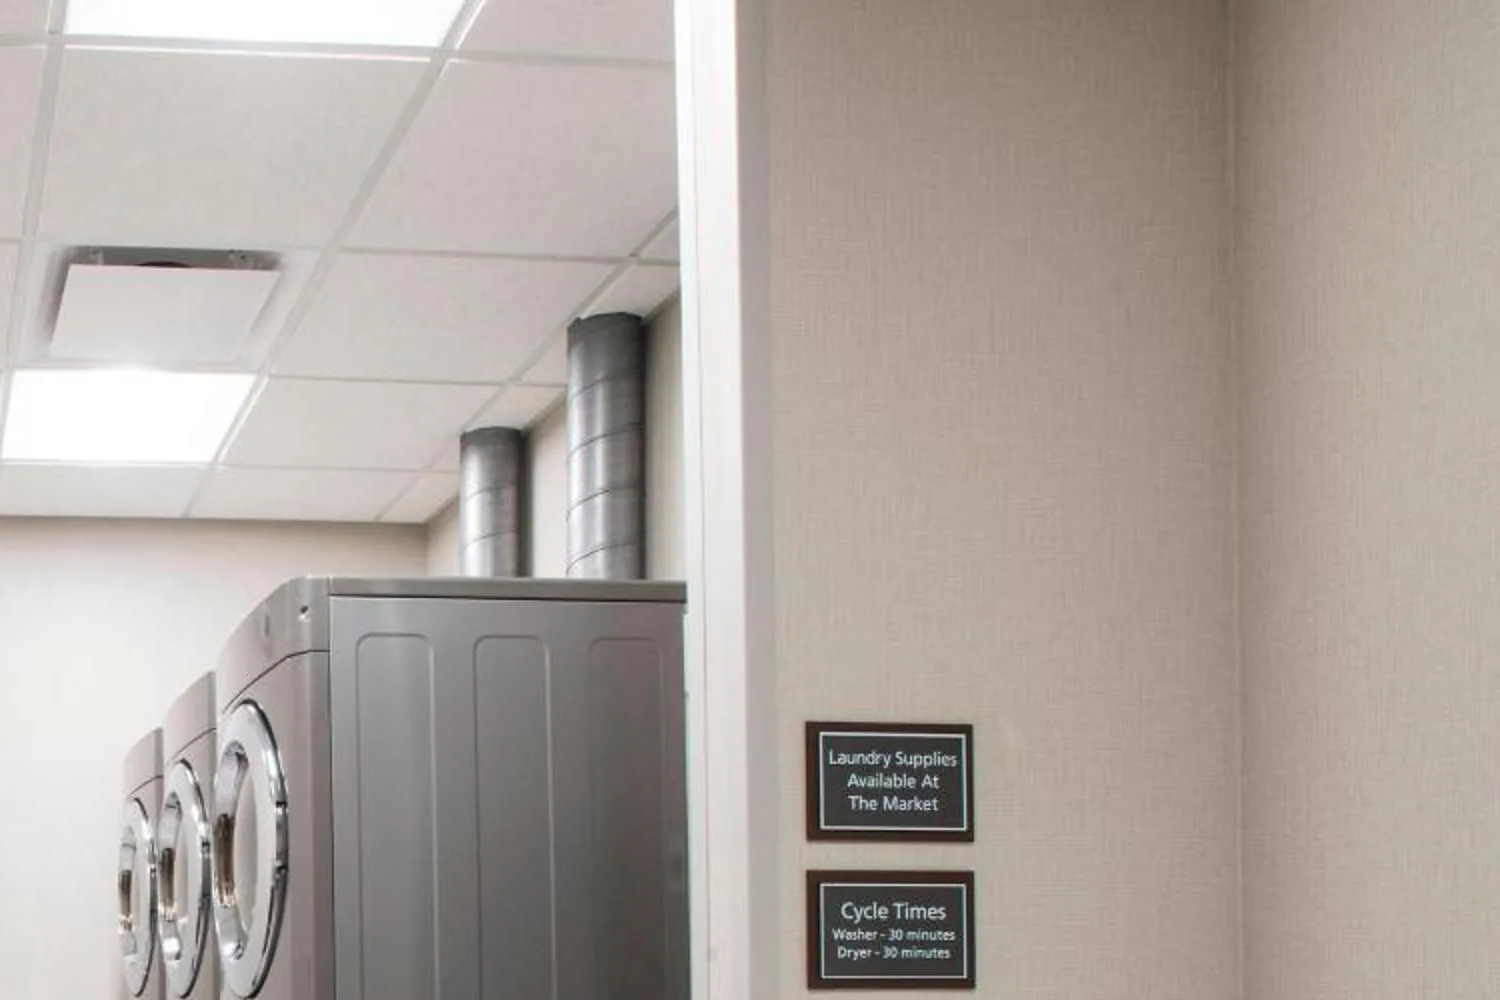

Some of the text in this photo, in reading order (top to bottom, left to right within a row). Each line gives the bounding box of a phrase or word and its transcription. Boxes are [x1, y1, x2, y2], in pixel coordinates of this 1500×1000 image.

[828, 749, 957, 768] Laundry Supplies
[847, 772, 940, 789] Available At
[847, 795, 940, 812] The Market
[841, 901, 947, 924] Cycle Times
[831, 928, 878, 941] Washer
[888, 928, 904, 941] 30
[905, 928, 956, 941] minutes
[837, 946, 873, 960] Dryer
[883, 946, 899, 959] 30
[900, 946, 951, 959] minutes
